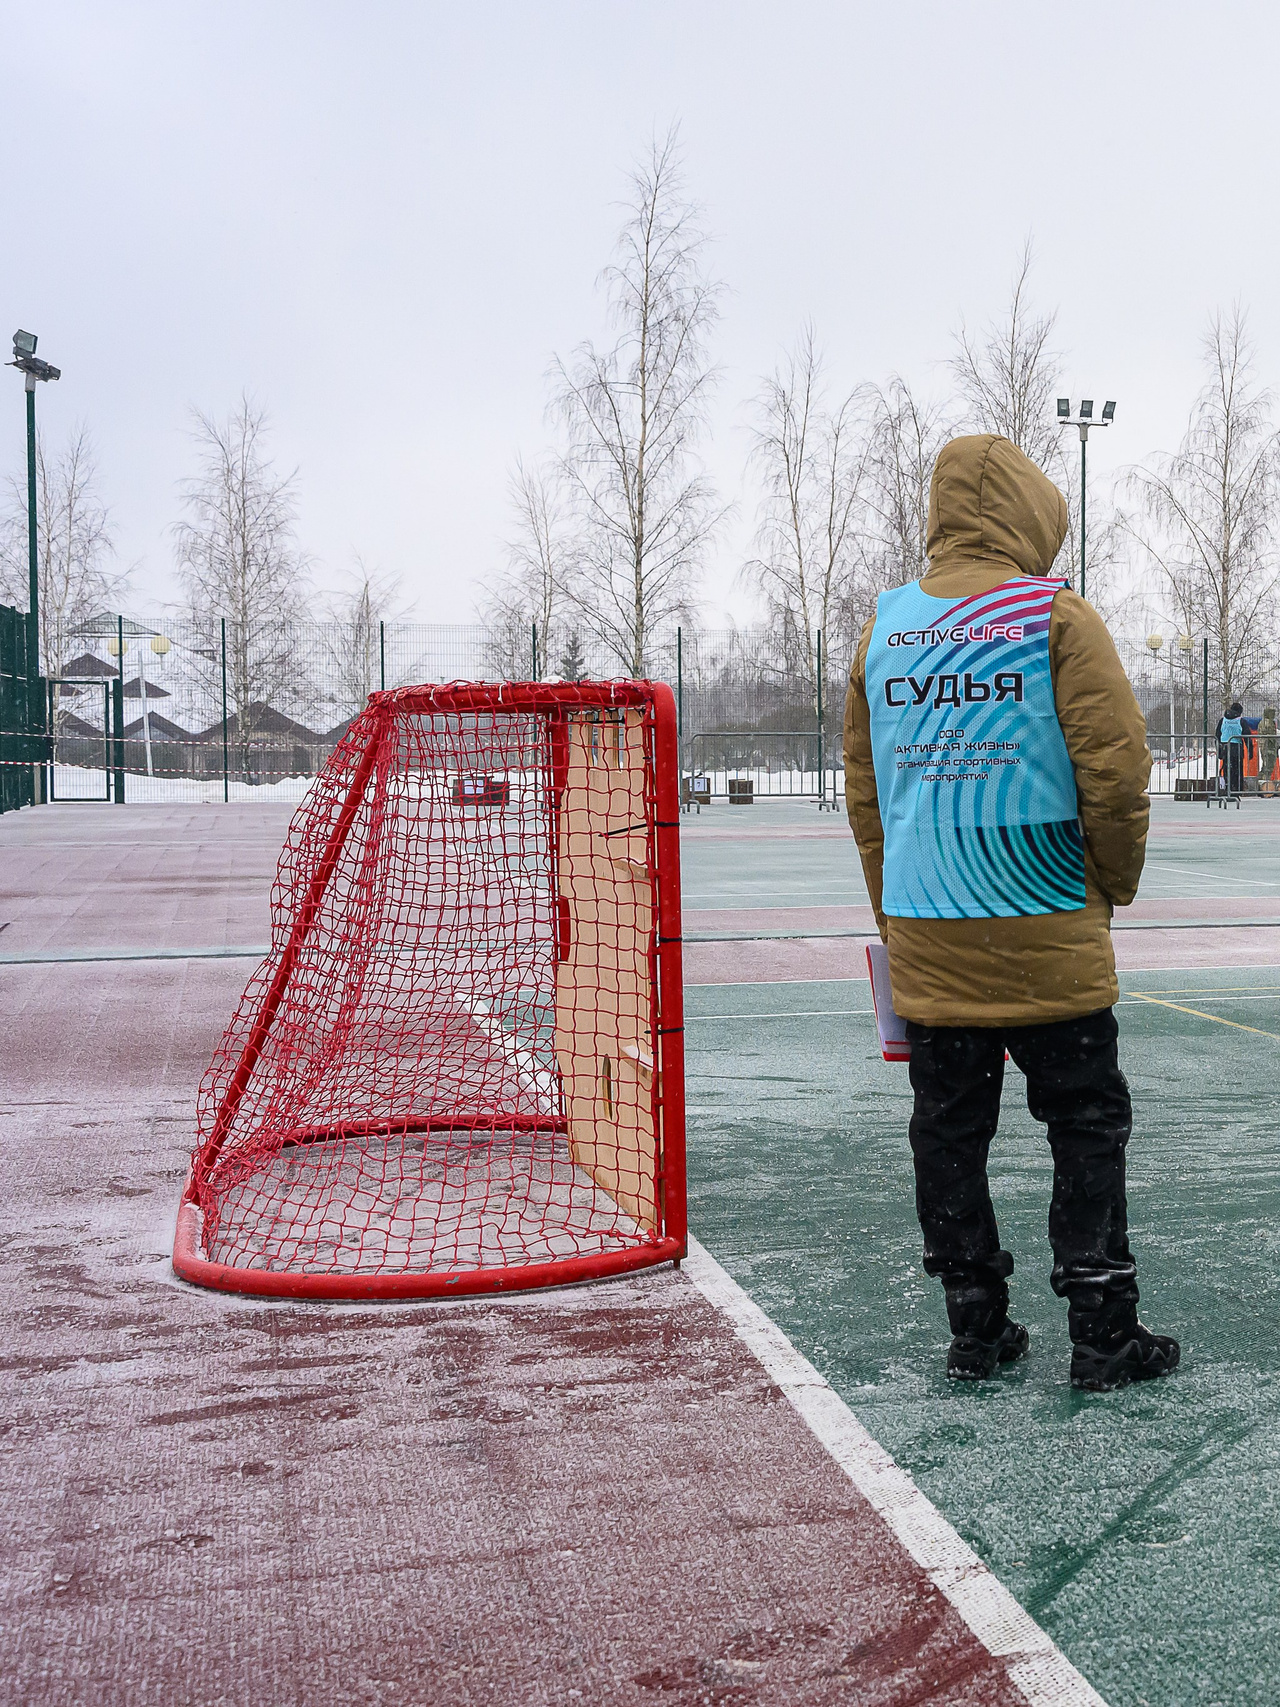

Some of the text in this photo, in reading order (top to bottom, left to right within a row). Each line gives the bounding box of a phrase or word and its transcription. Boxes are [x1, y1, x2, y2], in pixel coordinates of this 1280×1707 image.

[968, 625, 1023, 641] LIFE
[884, 672, 1023, 710] СУДЬЯ
[939, 729, 965, 739] ООО
[896, 757, 1021, 771] рганизация спортивных
[921, 771, 989, 783] мероприятий
